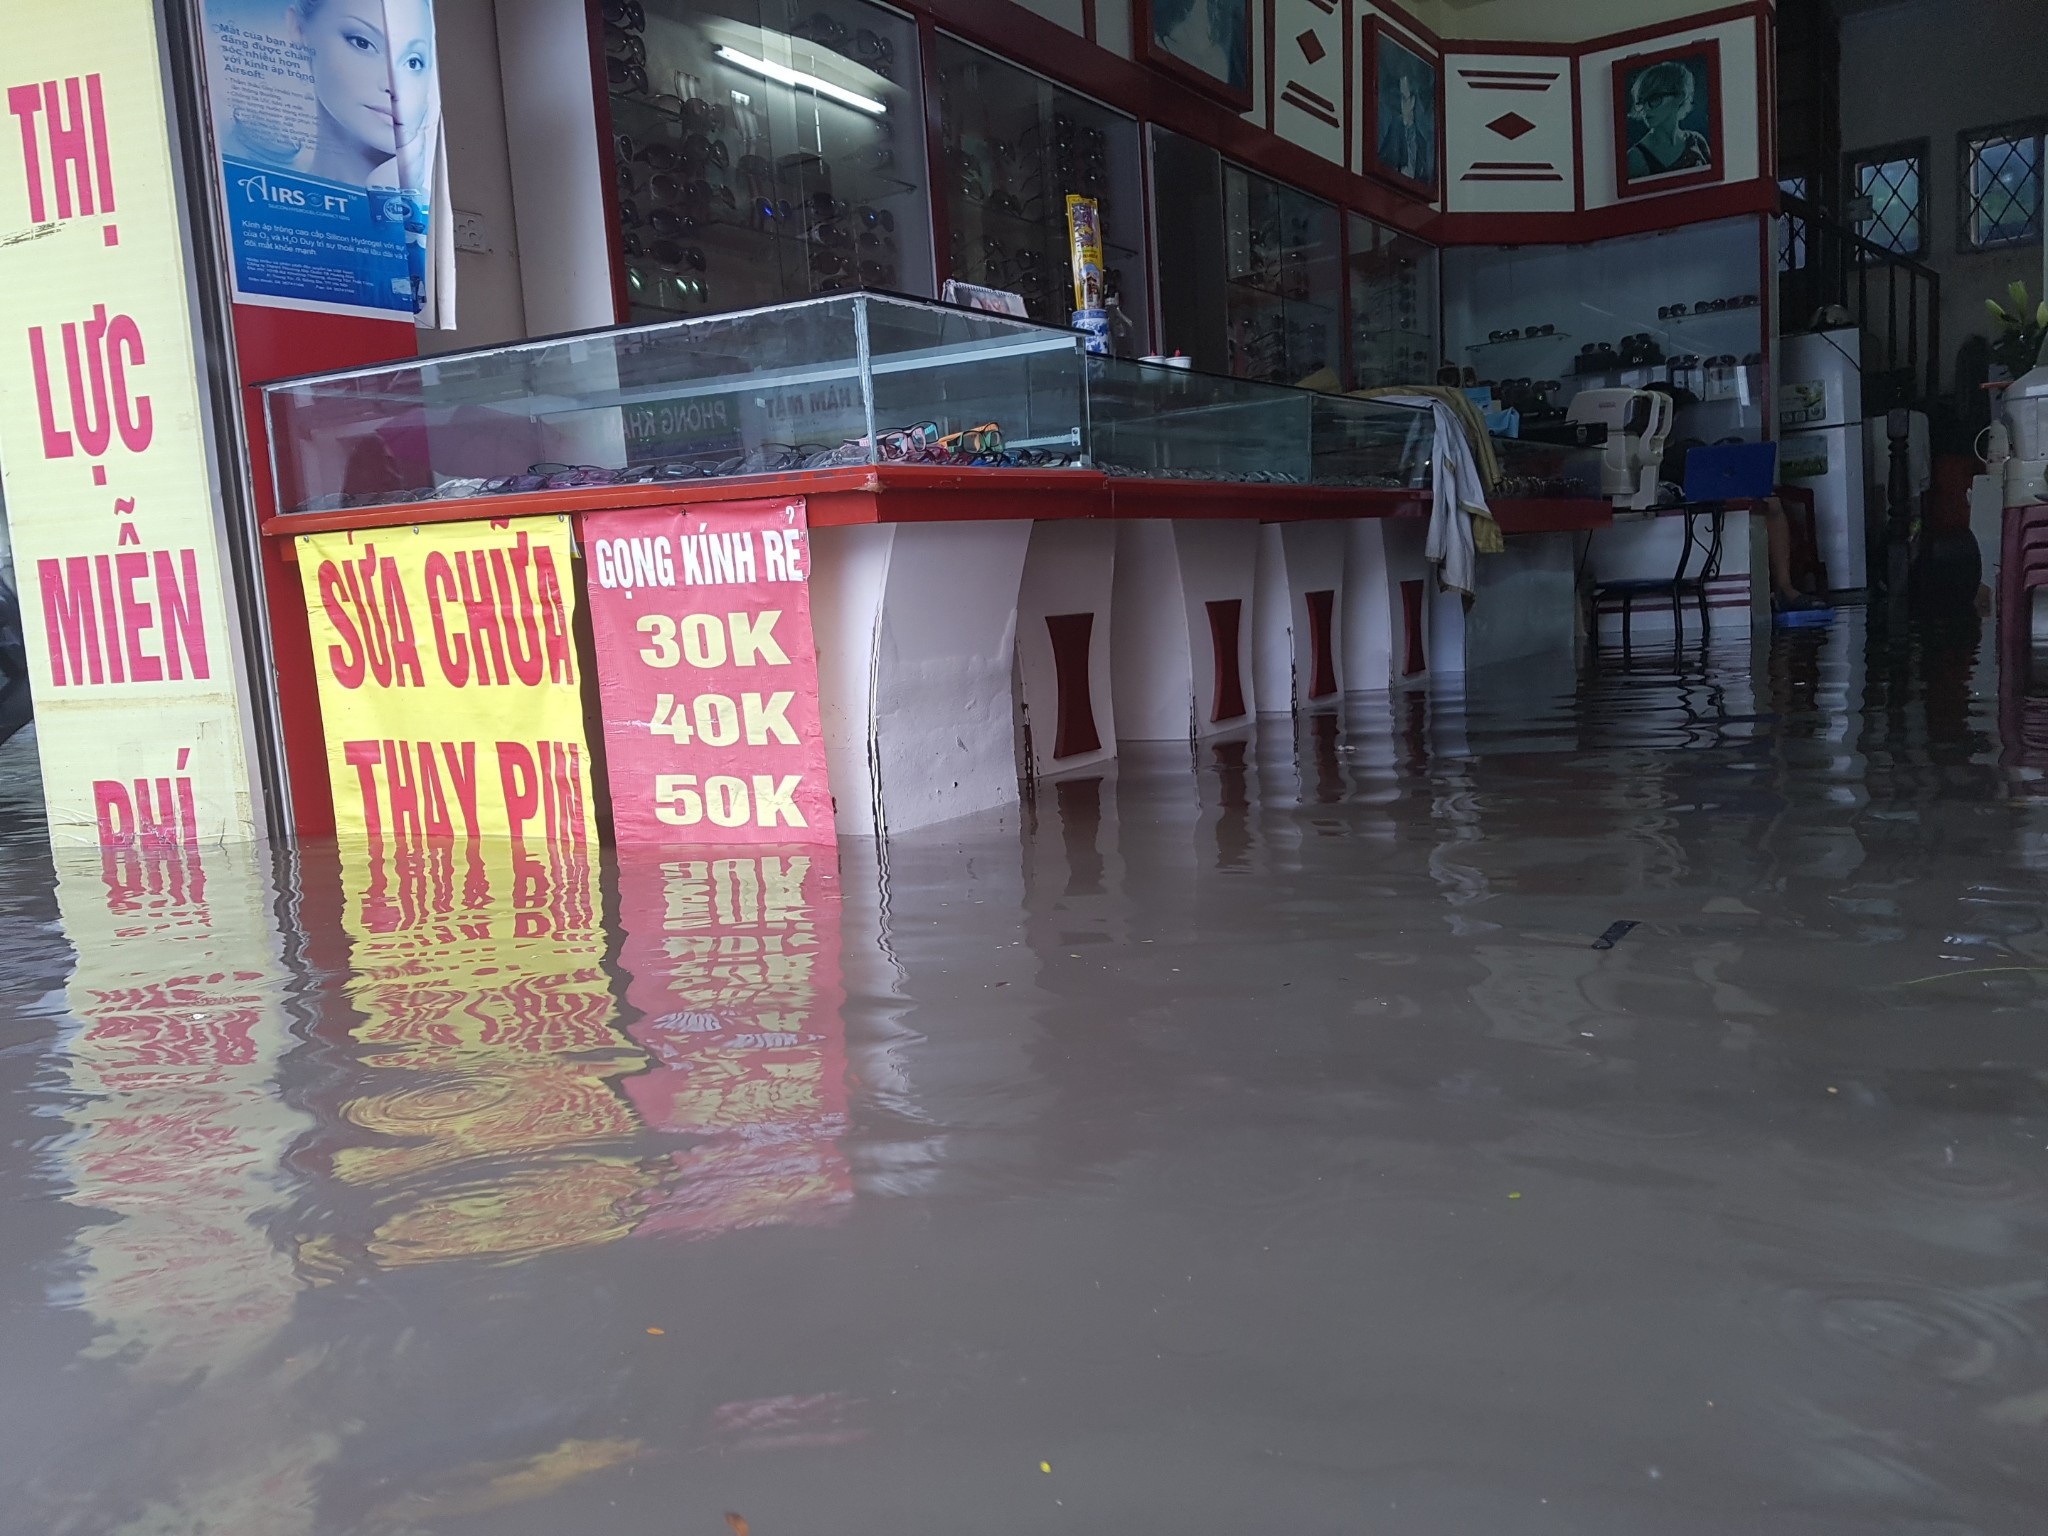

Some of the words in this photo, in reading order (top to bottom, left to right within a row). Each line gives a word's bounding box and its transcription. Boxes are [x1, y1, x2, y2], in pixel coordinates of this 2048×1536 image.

[7, 73, 118, 247] THỊ
[28, 303, 153, 487] LỰC
[37, 496, 210, 687] MIỄN
[595, 536, 676, 600] GỌNG
[680, 522, 757, 586] KÍNH
[762, 505, 804, 582] RẺ
[424, 519, 575, 689] CHỮA
[636, 610, 792, 669] 30K
[649, 690, 801, 747] 40K
[92, 747, 199, 849] PHÍ
[343, 739, 481, 838] THAY
[495, 739, 587, 840] PIN
[654, 773, 809, 829] 50K
